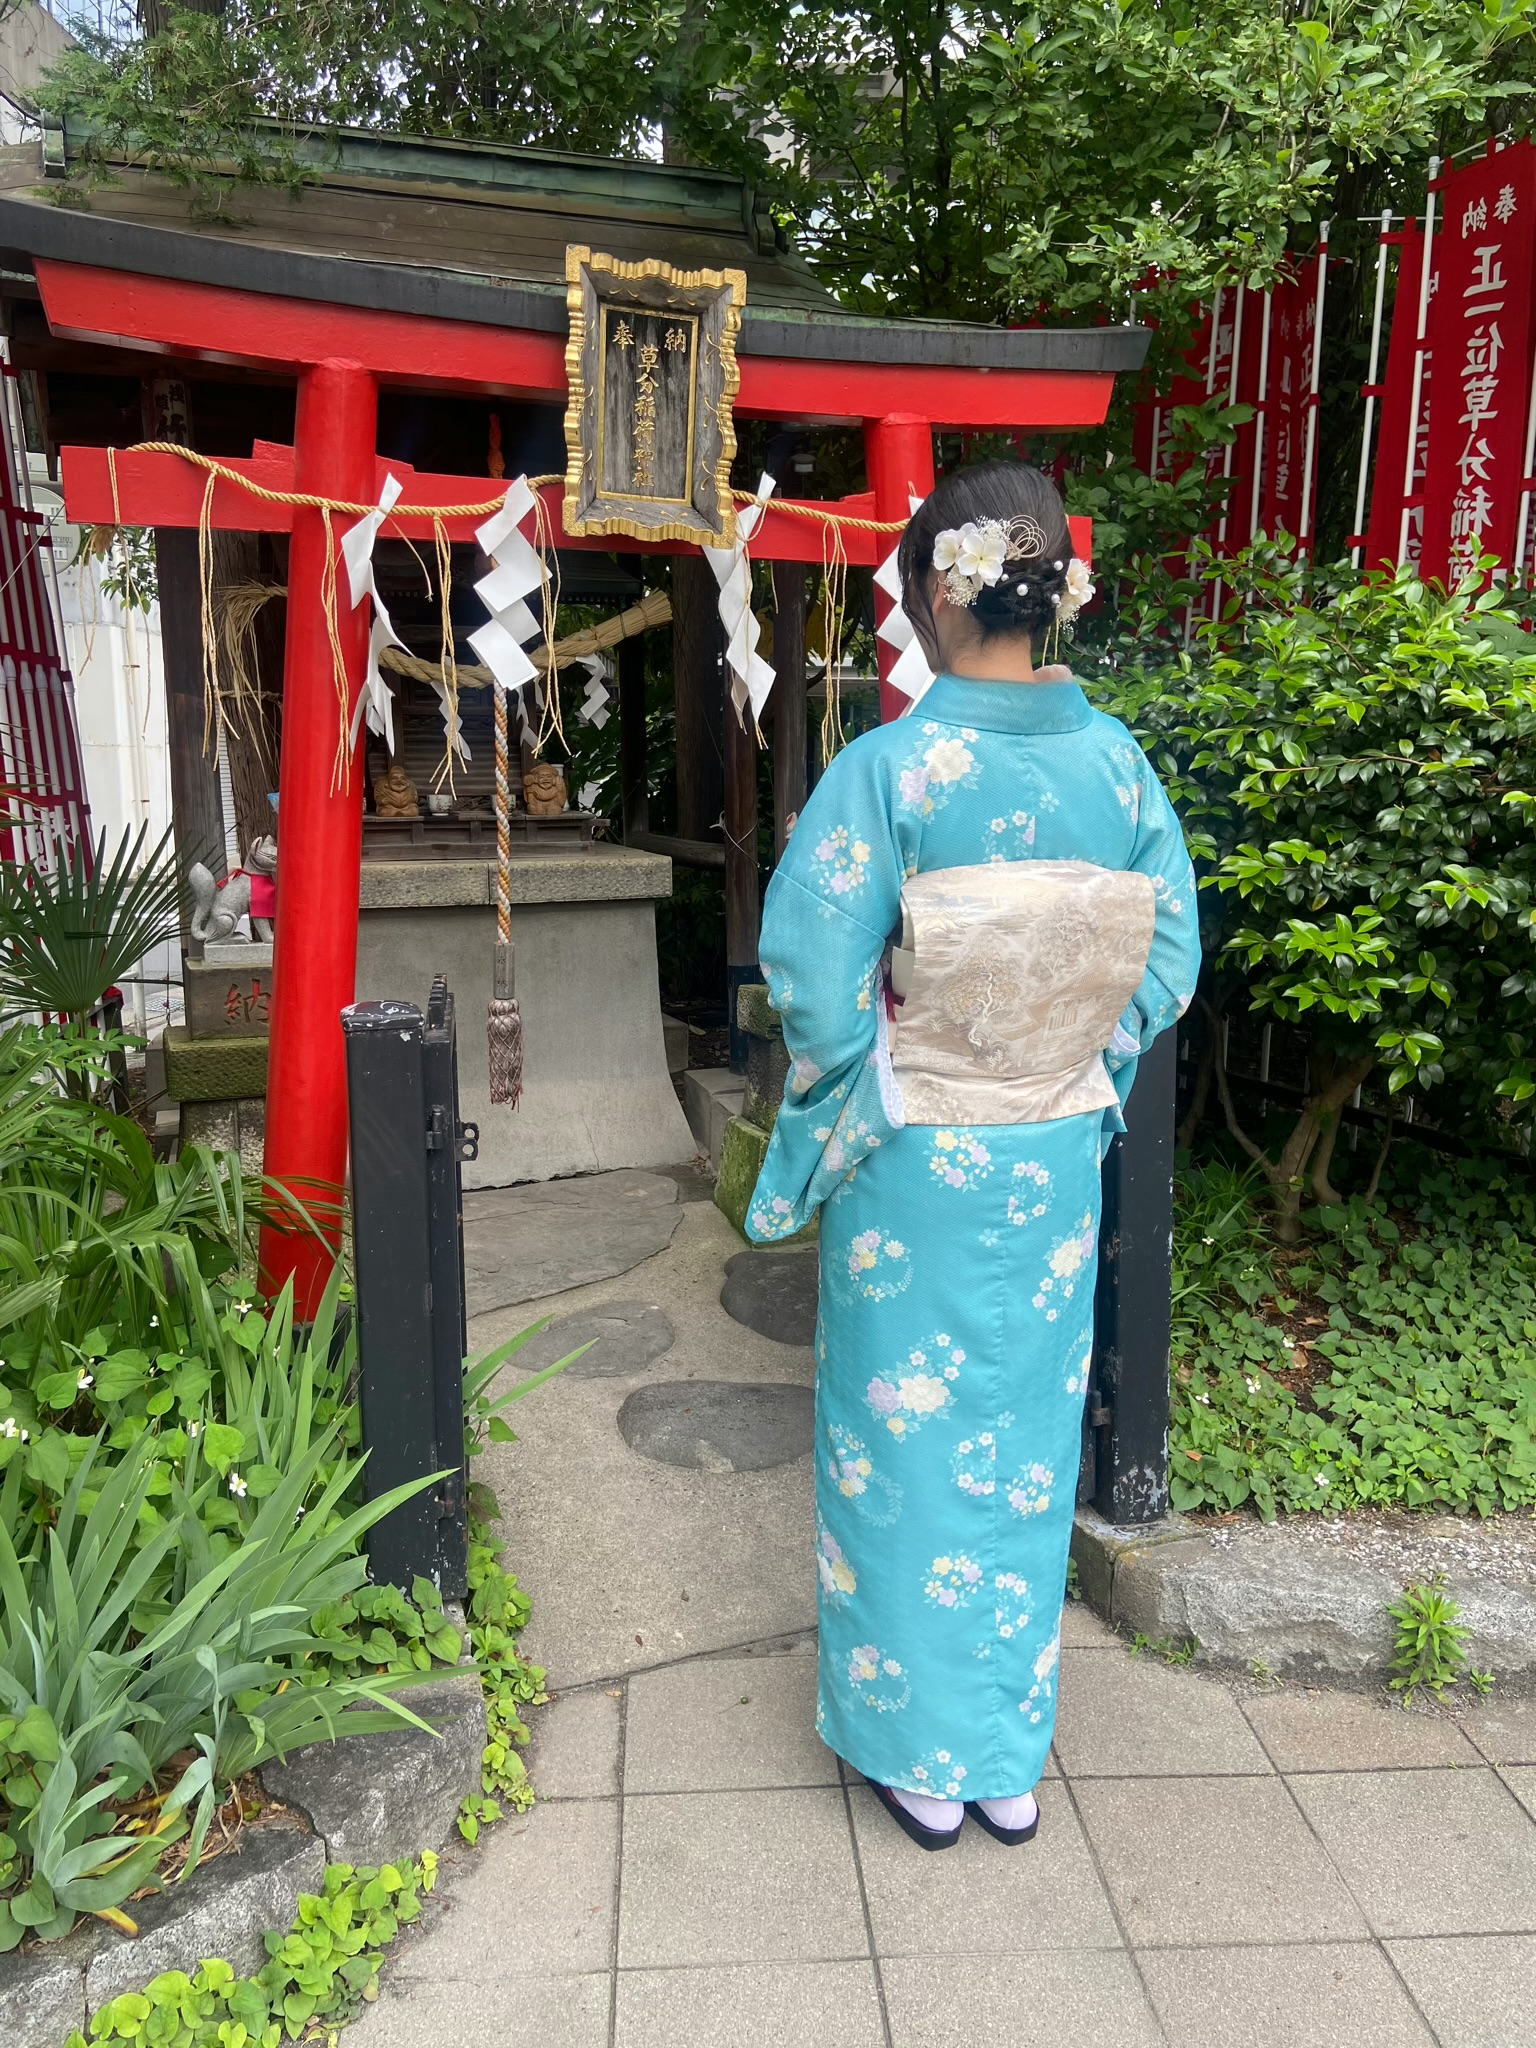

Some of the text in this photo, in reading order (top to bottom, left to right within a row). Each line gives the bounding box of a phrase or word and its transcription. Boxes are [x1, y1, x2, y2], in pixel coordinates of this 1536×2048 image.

[631, 343, 660, 488] 草分稲荷神社
